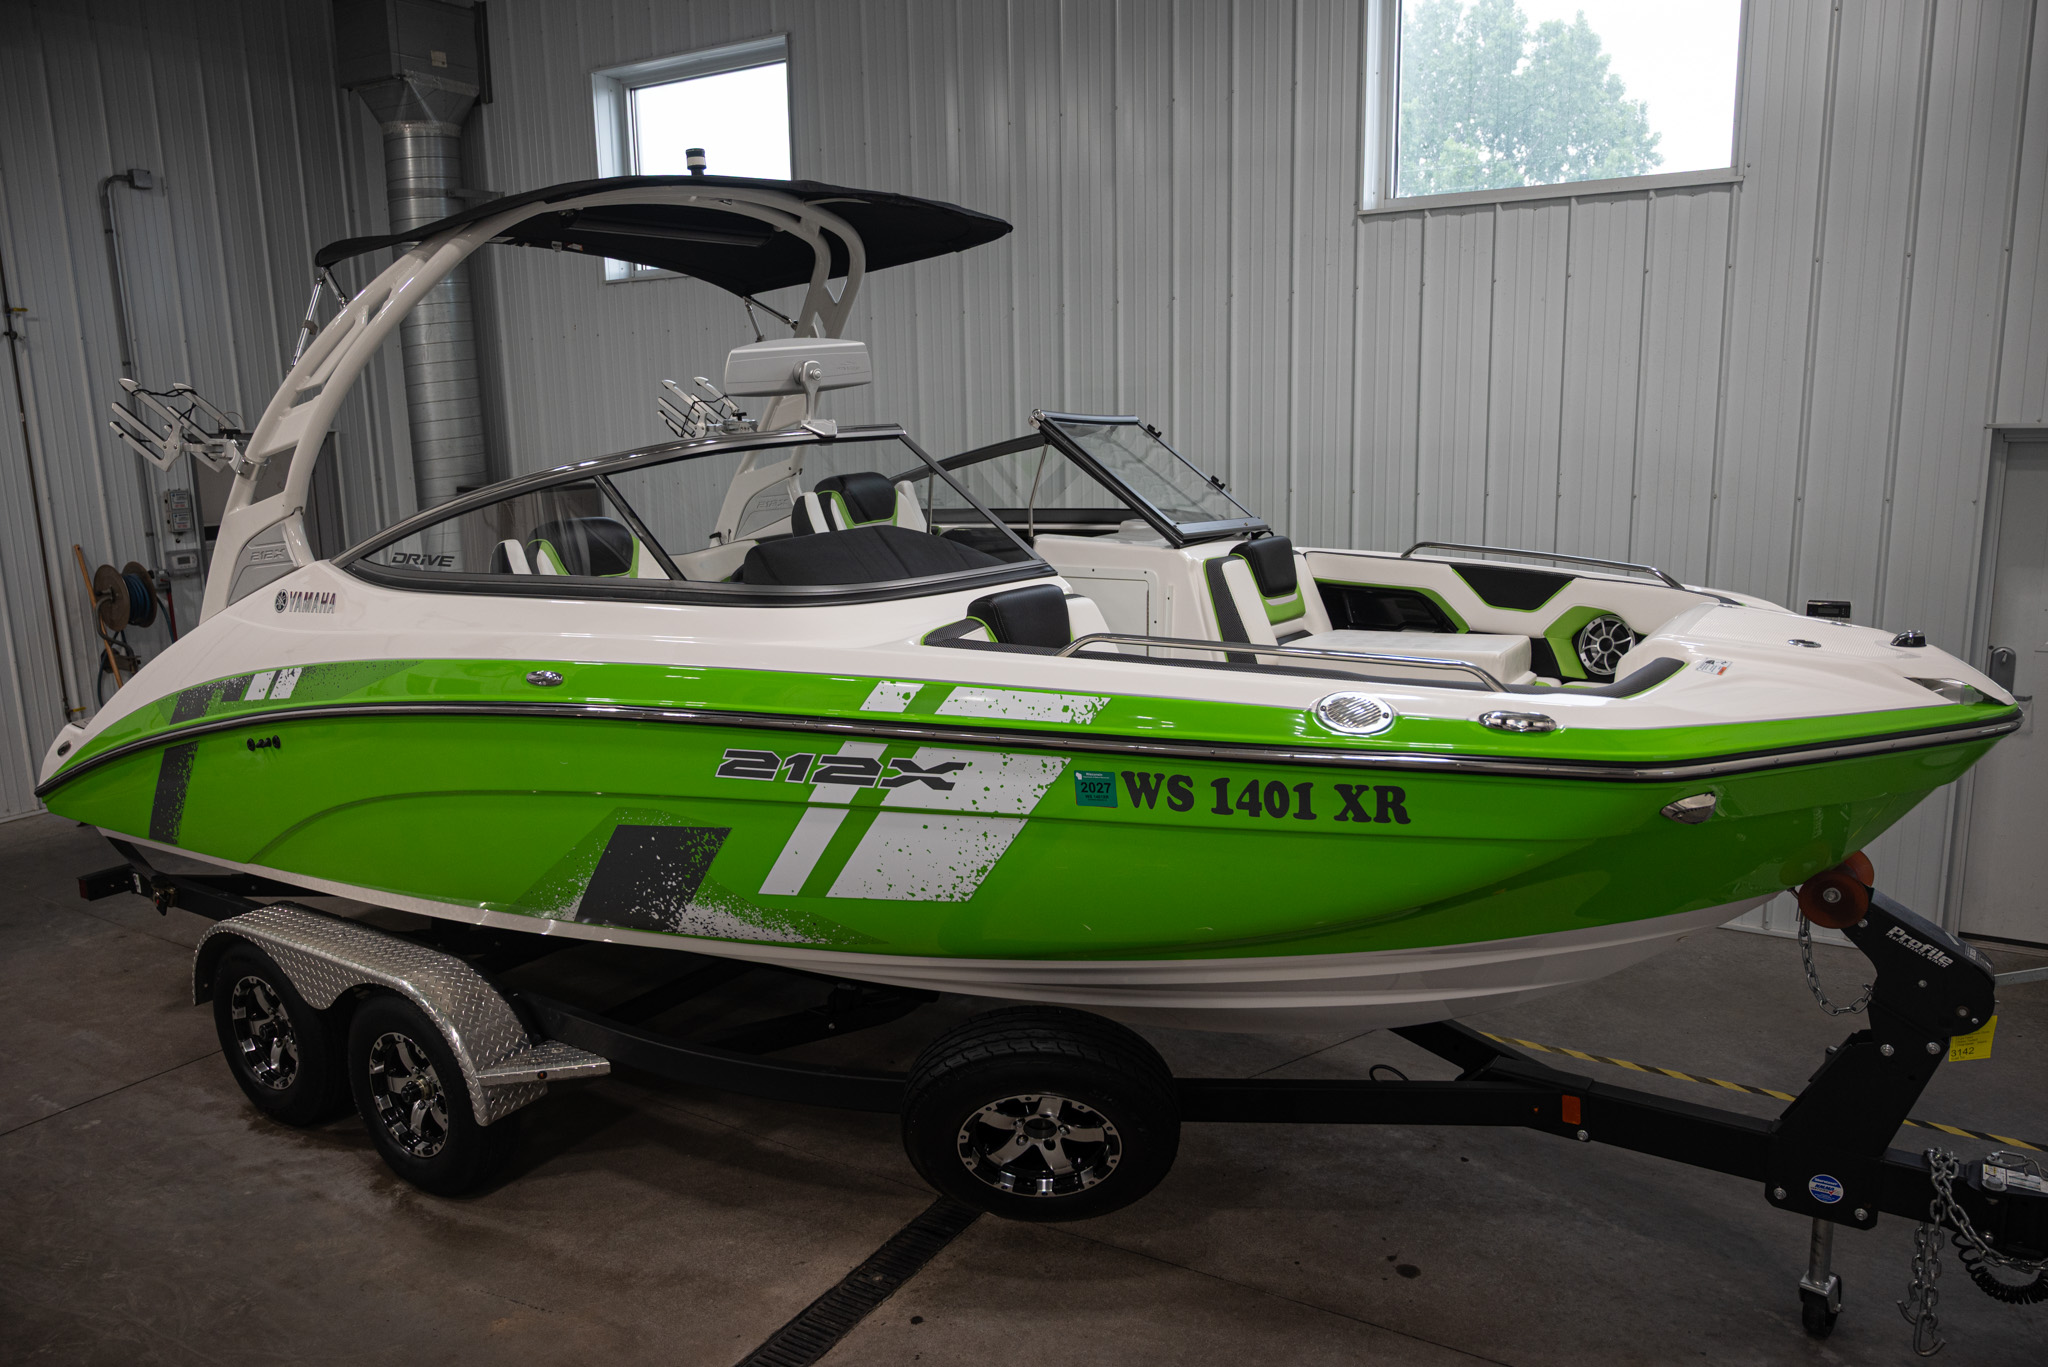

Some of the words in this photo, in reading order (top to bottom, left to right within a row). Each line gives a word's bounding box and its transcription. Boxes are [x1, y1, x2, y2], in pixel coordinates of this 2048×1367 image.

[289, 591, 336, 613] YAMAHA
[715, 748, 967, 791] 212X
[1080, 782, 1111, 793] 2027
[1121, 770, 1194, 812] WS
[1211, 777, 1317, 820] 1401
[1333, 783, 1411, 824] XR
[1885, 932, 1927, 957] PERFORMANCE
[1926, 955, 1949, 968] WINCH
[1887, 926, 1954, 966] Profile
[1951, 1047, 1975, 1058] 3142
